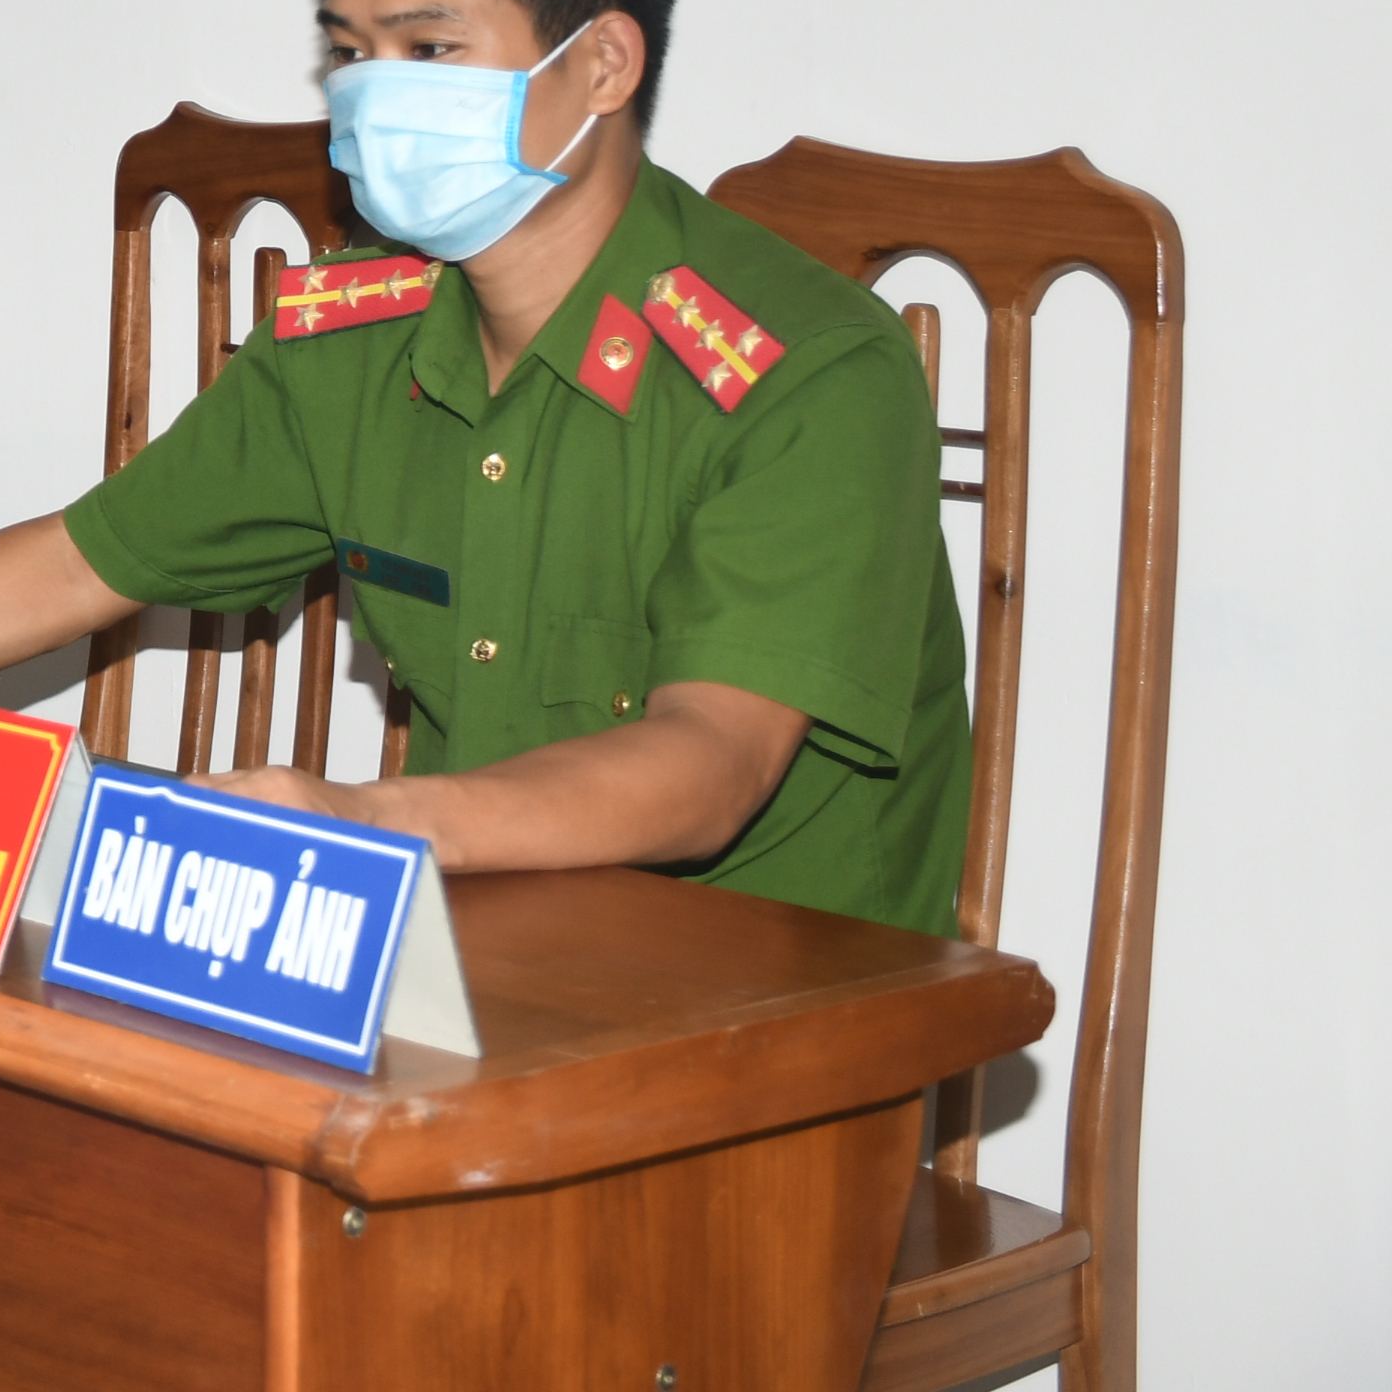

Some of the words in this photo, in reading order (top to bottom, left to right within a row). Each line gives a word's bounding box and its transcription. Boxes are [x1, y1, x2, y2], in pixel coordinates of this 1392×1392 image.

[82, 815, 173, 935] BÀN
[164, 850, 275, 979] CHỤP
[265, 848, 367, 993] ẢNH
